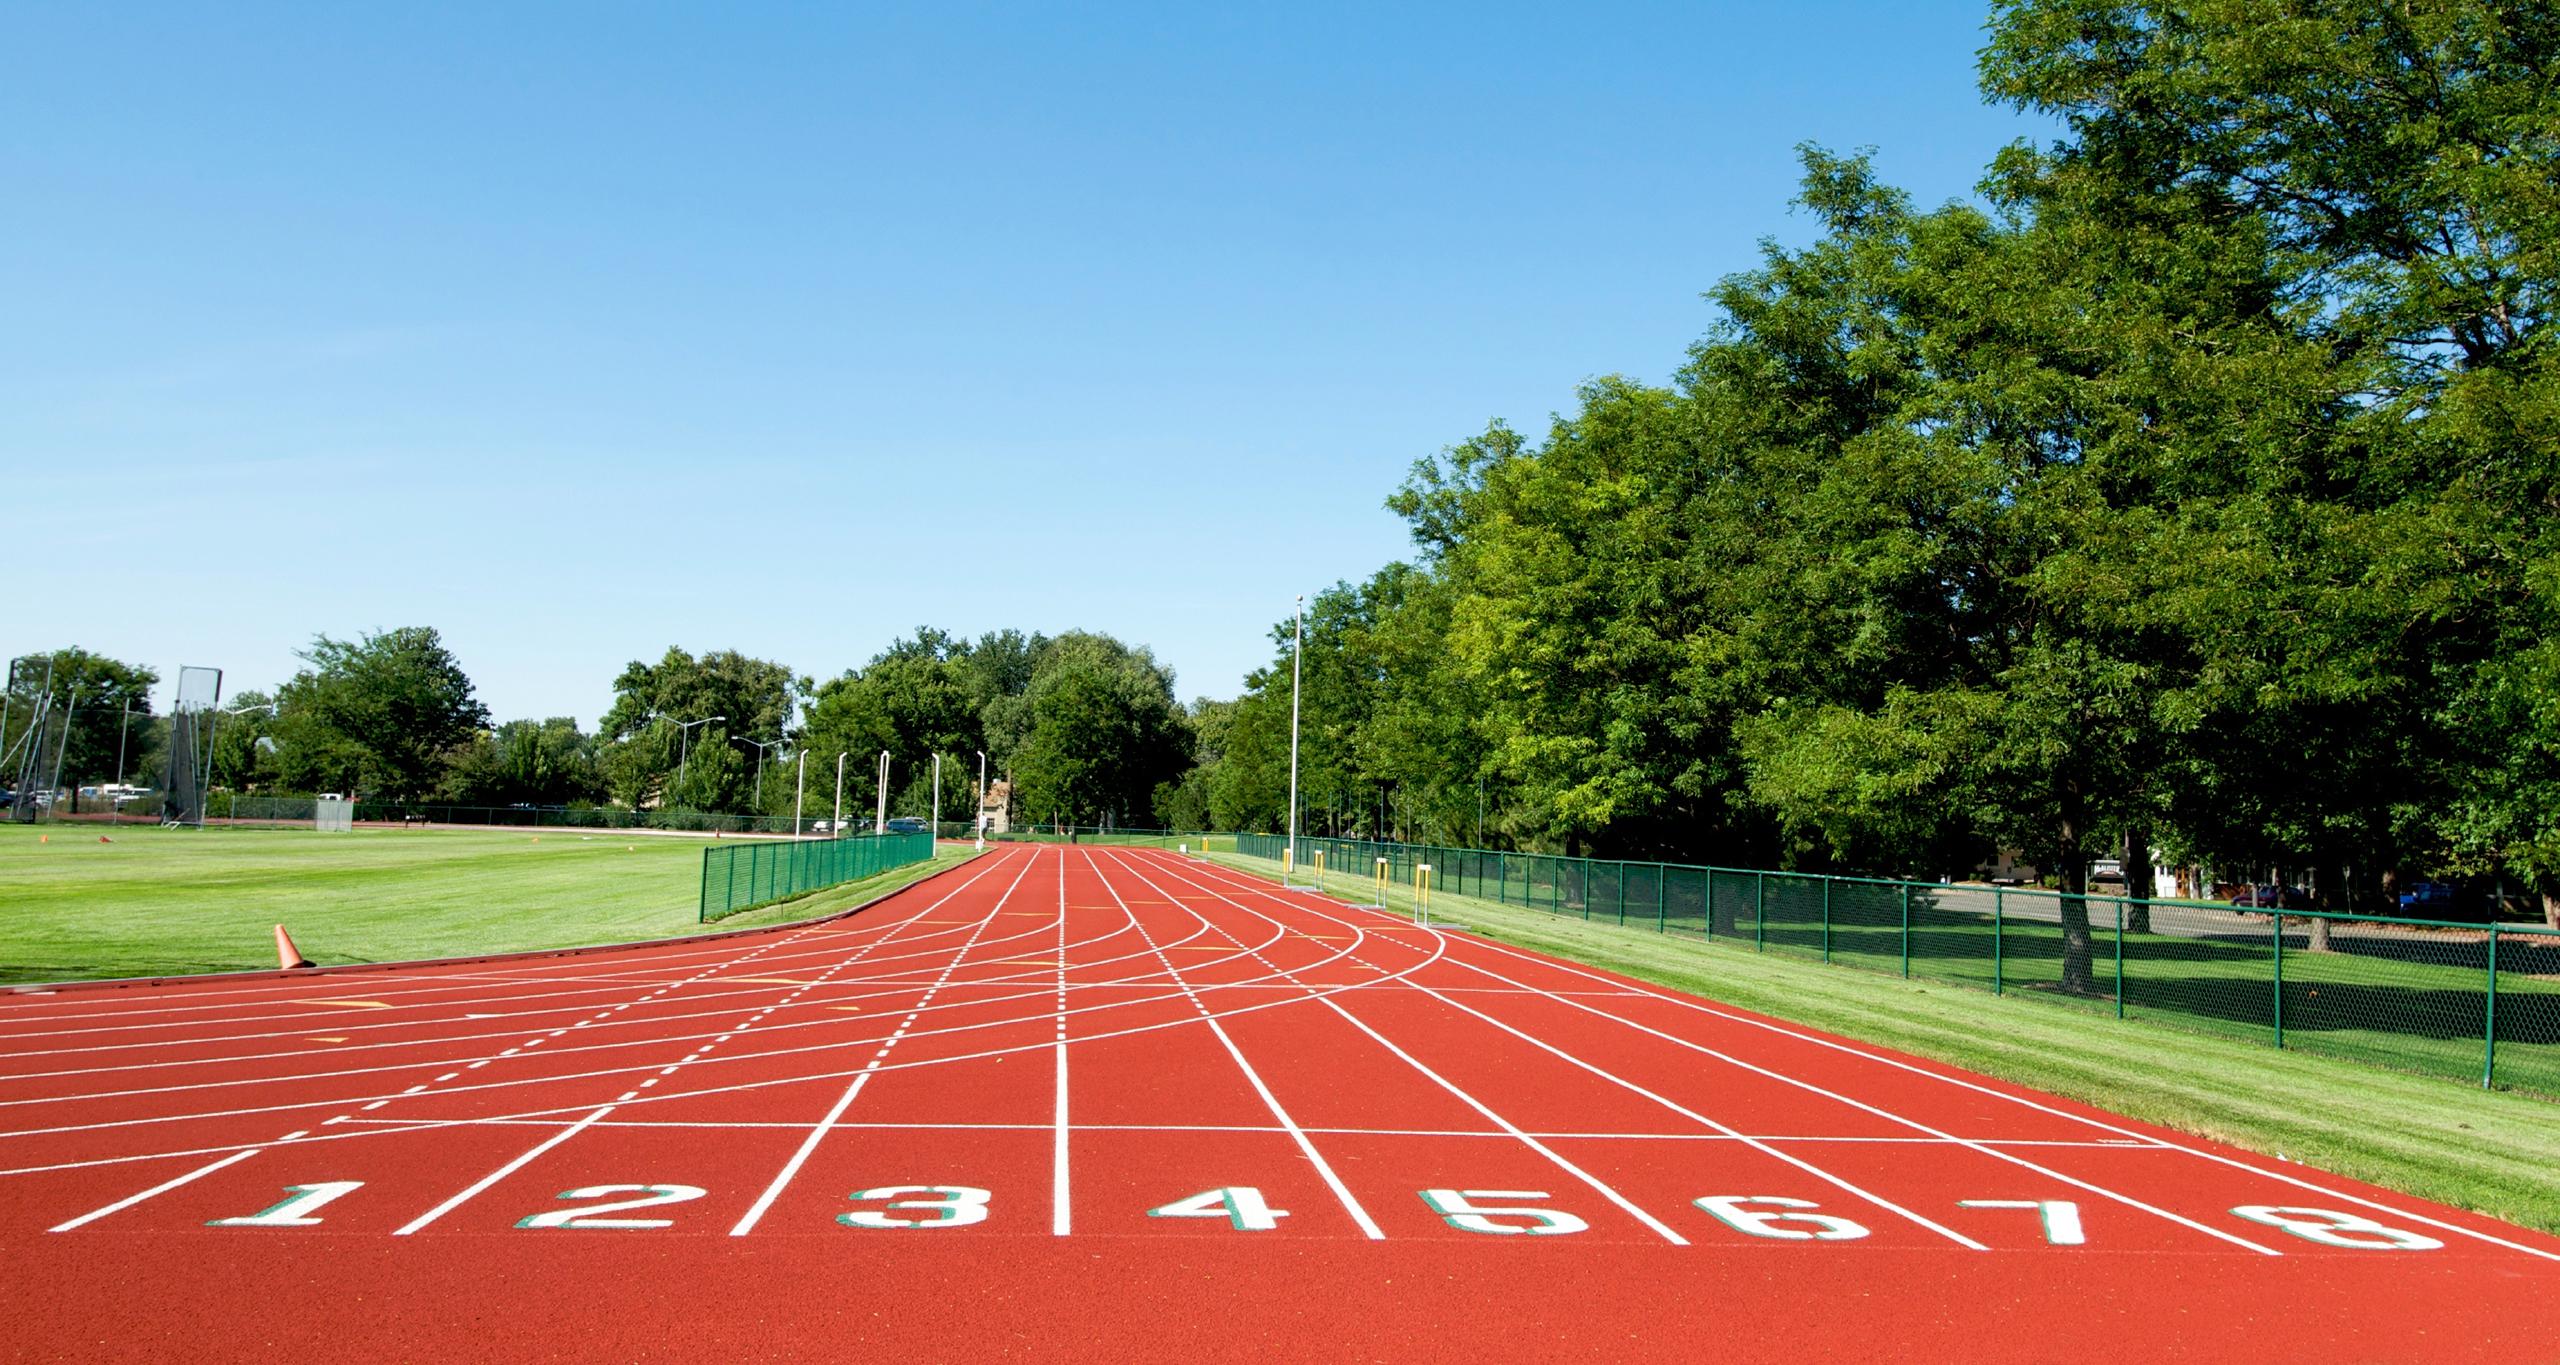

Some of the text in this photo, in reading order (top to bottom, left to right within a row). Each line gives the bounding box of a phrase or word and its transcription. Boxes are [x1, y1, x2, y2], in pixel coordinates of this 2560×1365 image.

[204, 1180, 365, 1226] 1
[514, 1184, 707, 1229] 2
[836, 1186, 991, 1229] 3
[1147, 1187, 1289, 1231] 4
[1418, 1189, 1589, 1235] 5
[1692, 1195, 1870, 1240] 6
[1956, 1200, 2085, 1245] 7
[2229, 1205, 2445, 1251] 8
